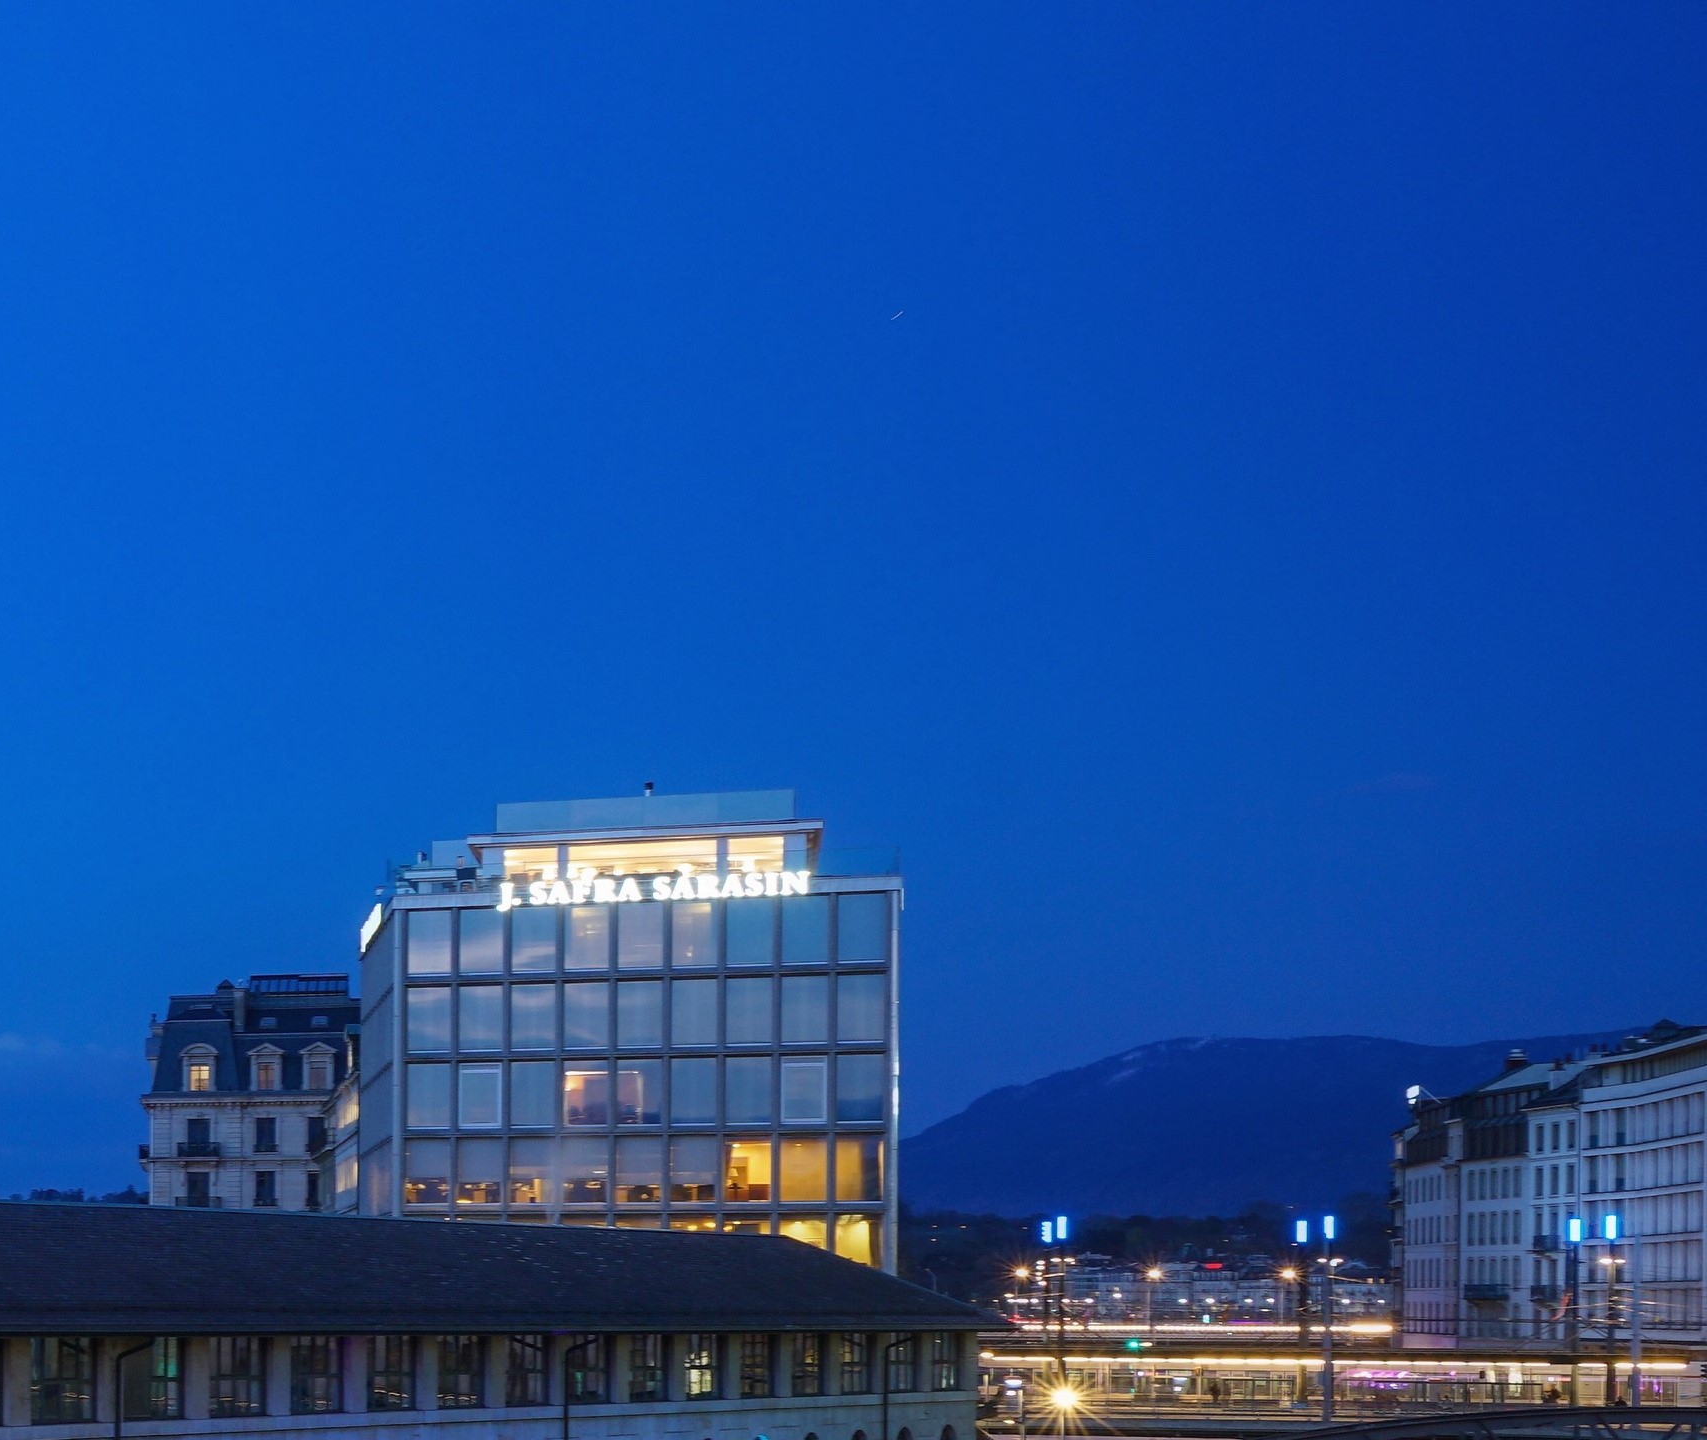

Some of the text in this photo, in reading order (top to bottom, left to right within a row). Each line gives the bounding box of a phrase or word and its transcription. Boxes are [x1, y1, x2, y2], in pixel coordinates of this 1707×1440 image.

[497, 870, 811, 912] J. SAFRA SARASIN
